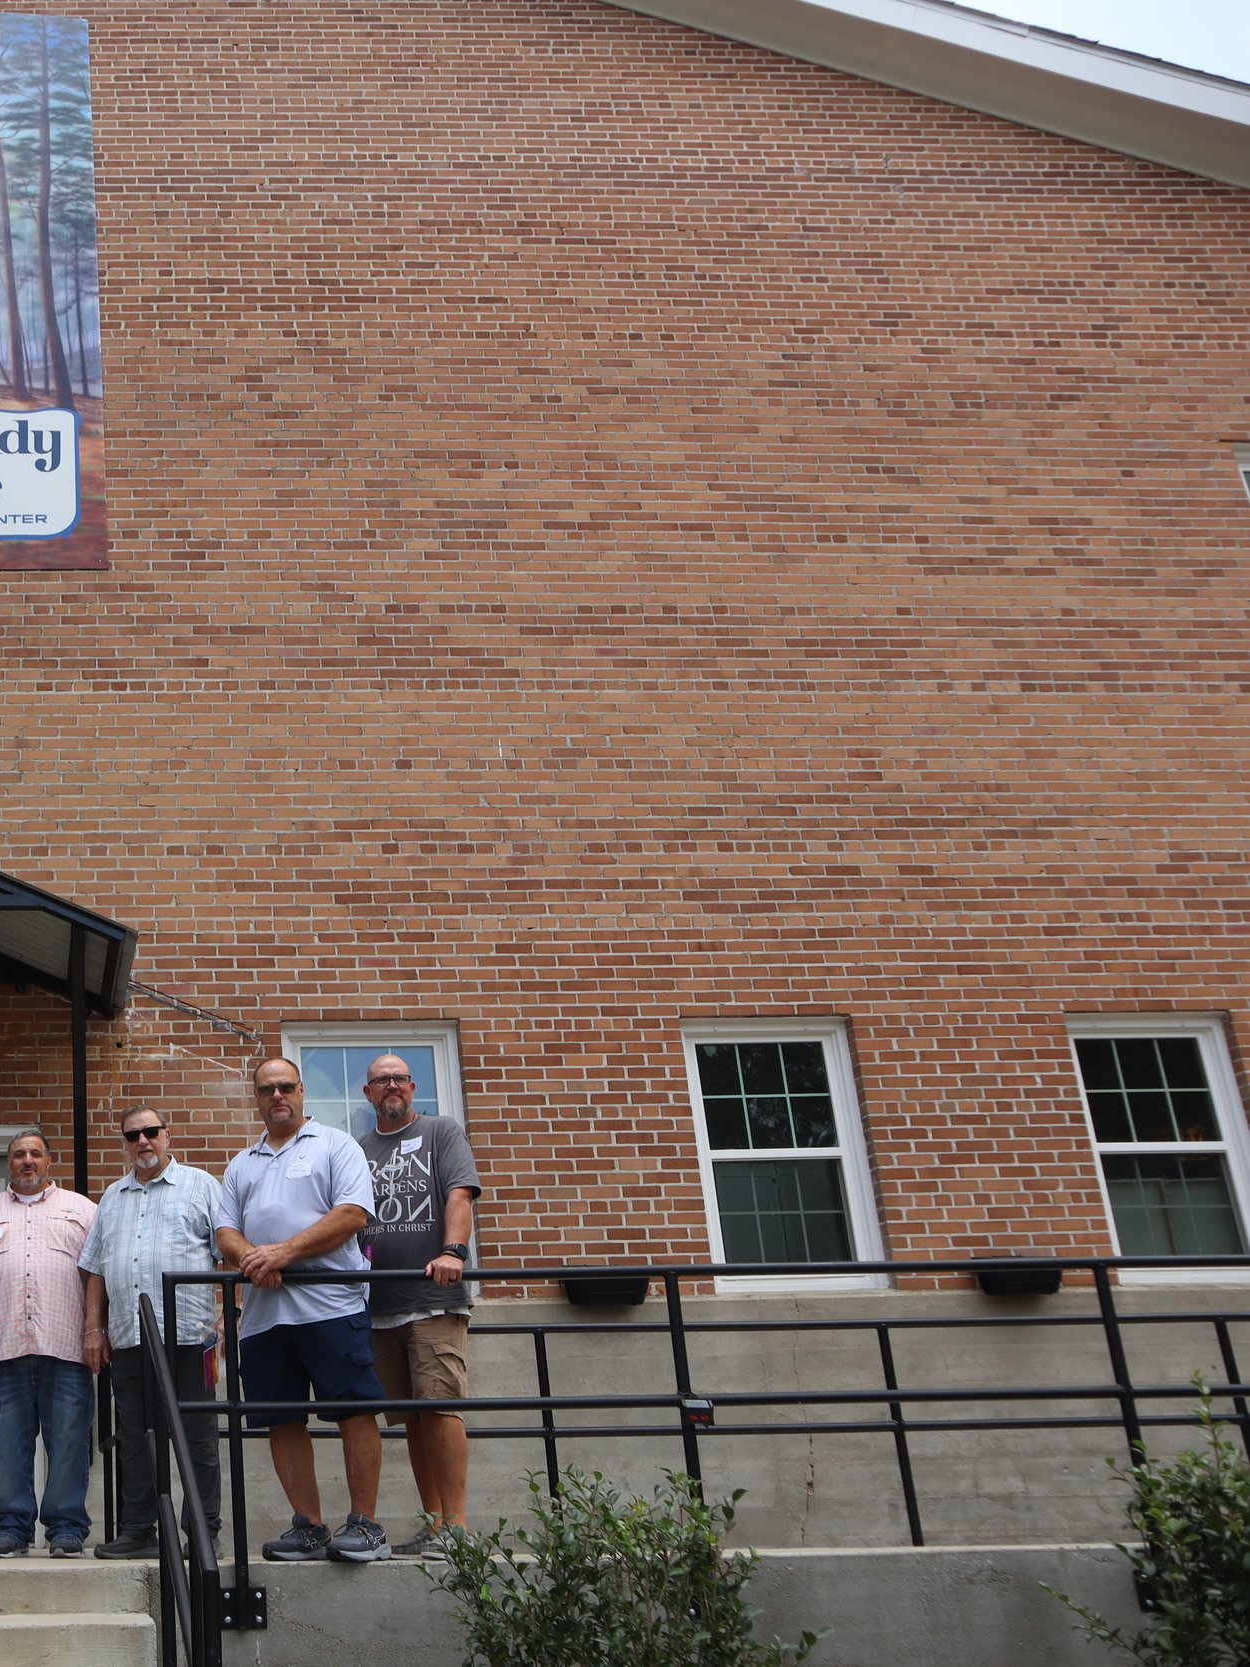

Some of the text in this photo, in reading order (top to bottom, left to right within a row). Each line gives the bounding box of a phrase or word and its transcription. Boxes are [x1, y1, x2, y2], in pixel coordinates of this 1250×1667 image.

[367, 1152, 431, 1182] RON
[387, 1223, 396, 1233] IN
[398, 1223, 432, 1232] CHRIST
